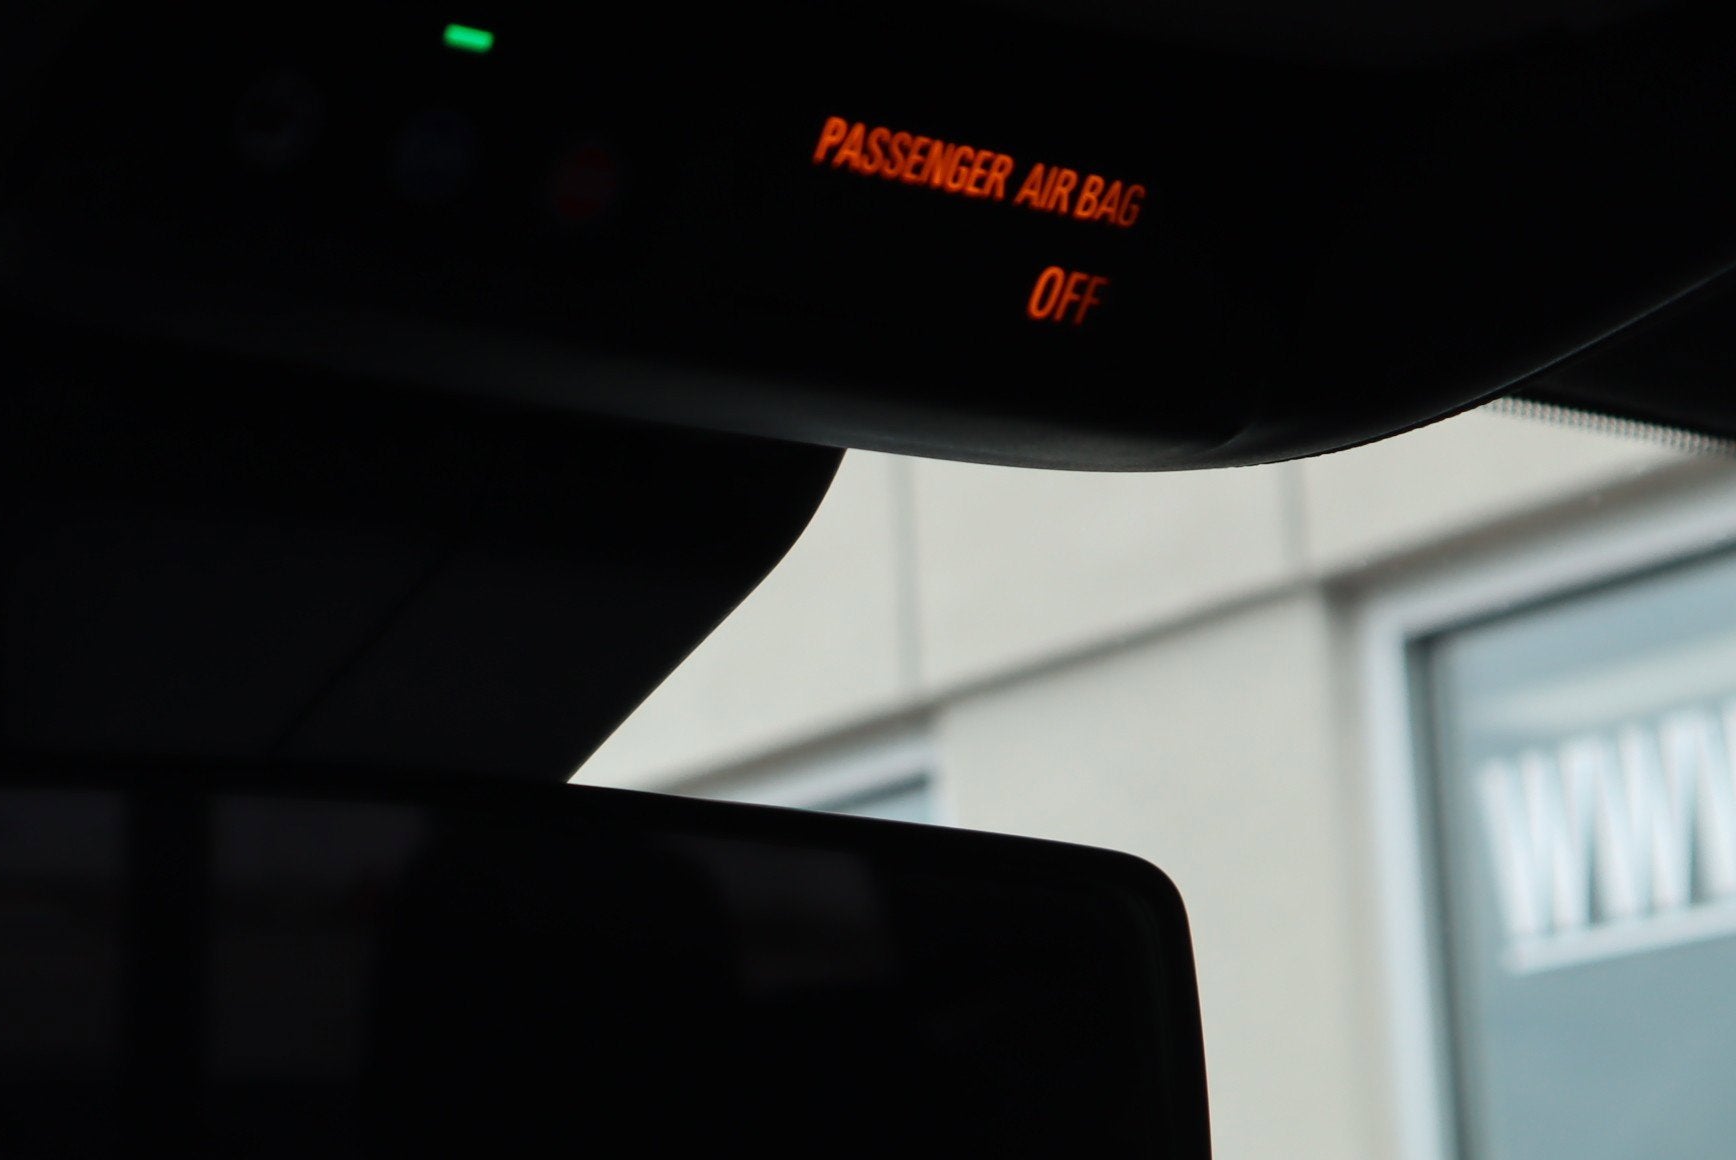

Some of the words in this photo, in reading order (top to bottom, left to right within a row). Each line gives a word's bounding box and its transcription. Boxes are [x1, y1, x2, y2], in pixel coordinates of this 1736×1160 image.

[812, 115, 1015, 201] PASSENGER
[1013, 162, 1079, 215] AIR
[1073, 173, 1146, 227] BAG
[1026, 265, 1109, 324] OFF
